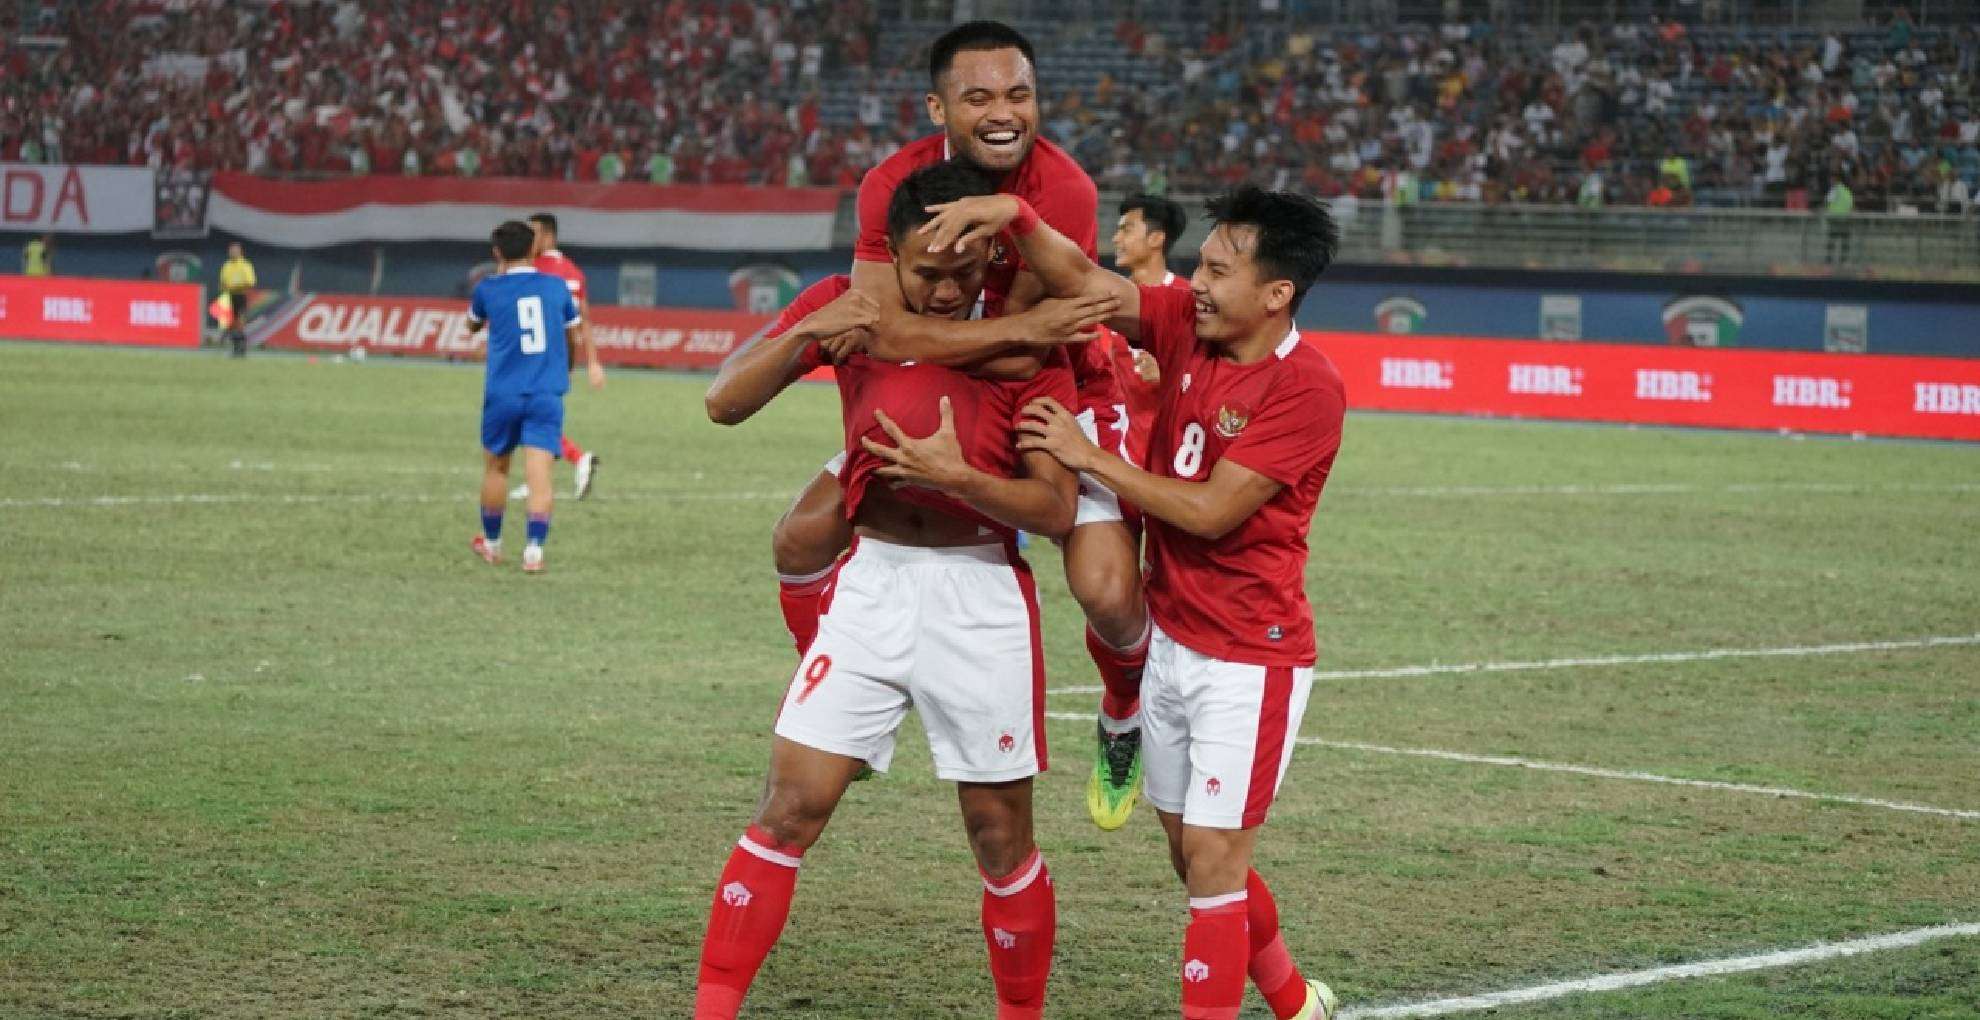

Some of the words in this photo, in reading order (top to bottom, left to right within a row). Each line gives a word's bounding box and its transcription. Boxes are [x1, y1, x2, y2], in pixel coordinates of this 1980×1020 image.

[4, 166, 89, 224] DA
[517, 296, 546, 355] 9
[636, 328, 683, 351] CUP
[1174, 422, 1205, 478] 8
[796, 654, 832, 705] 9
